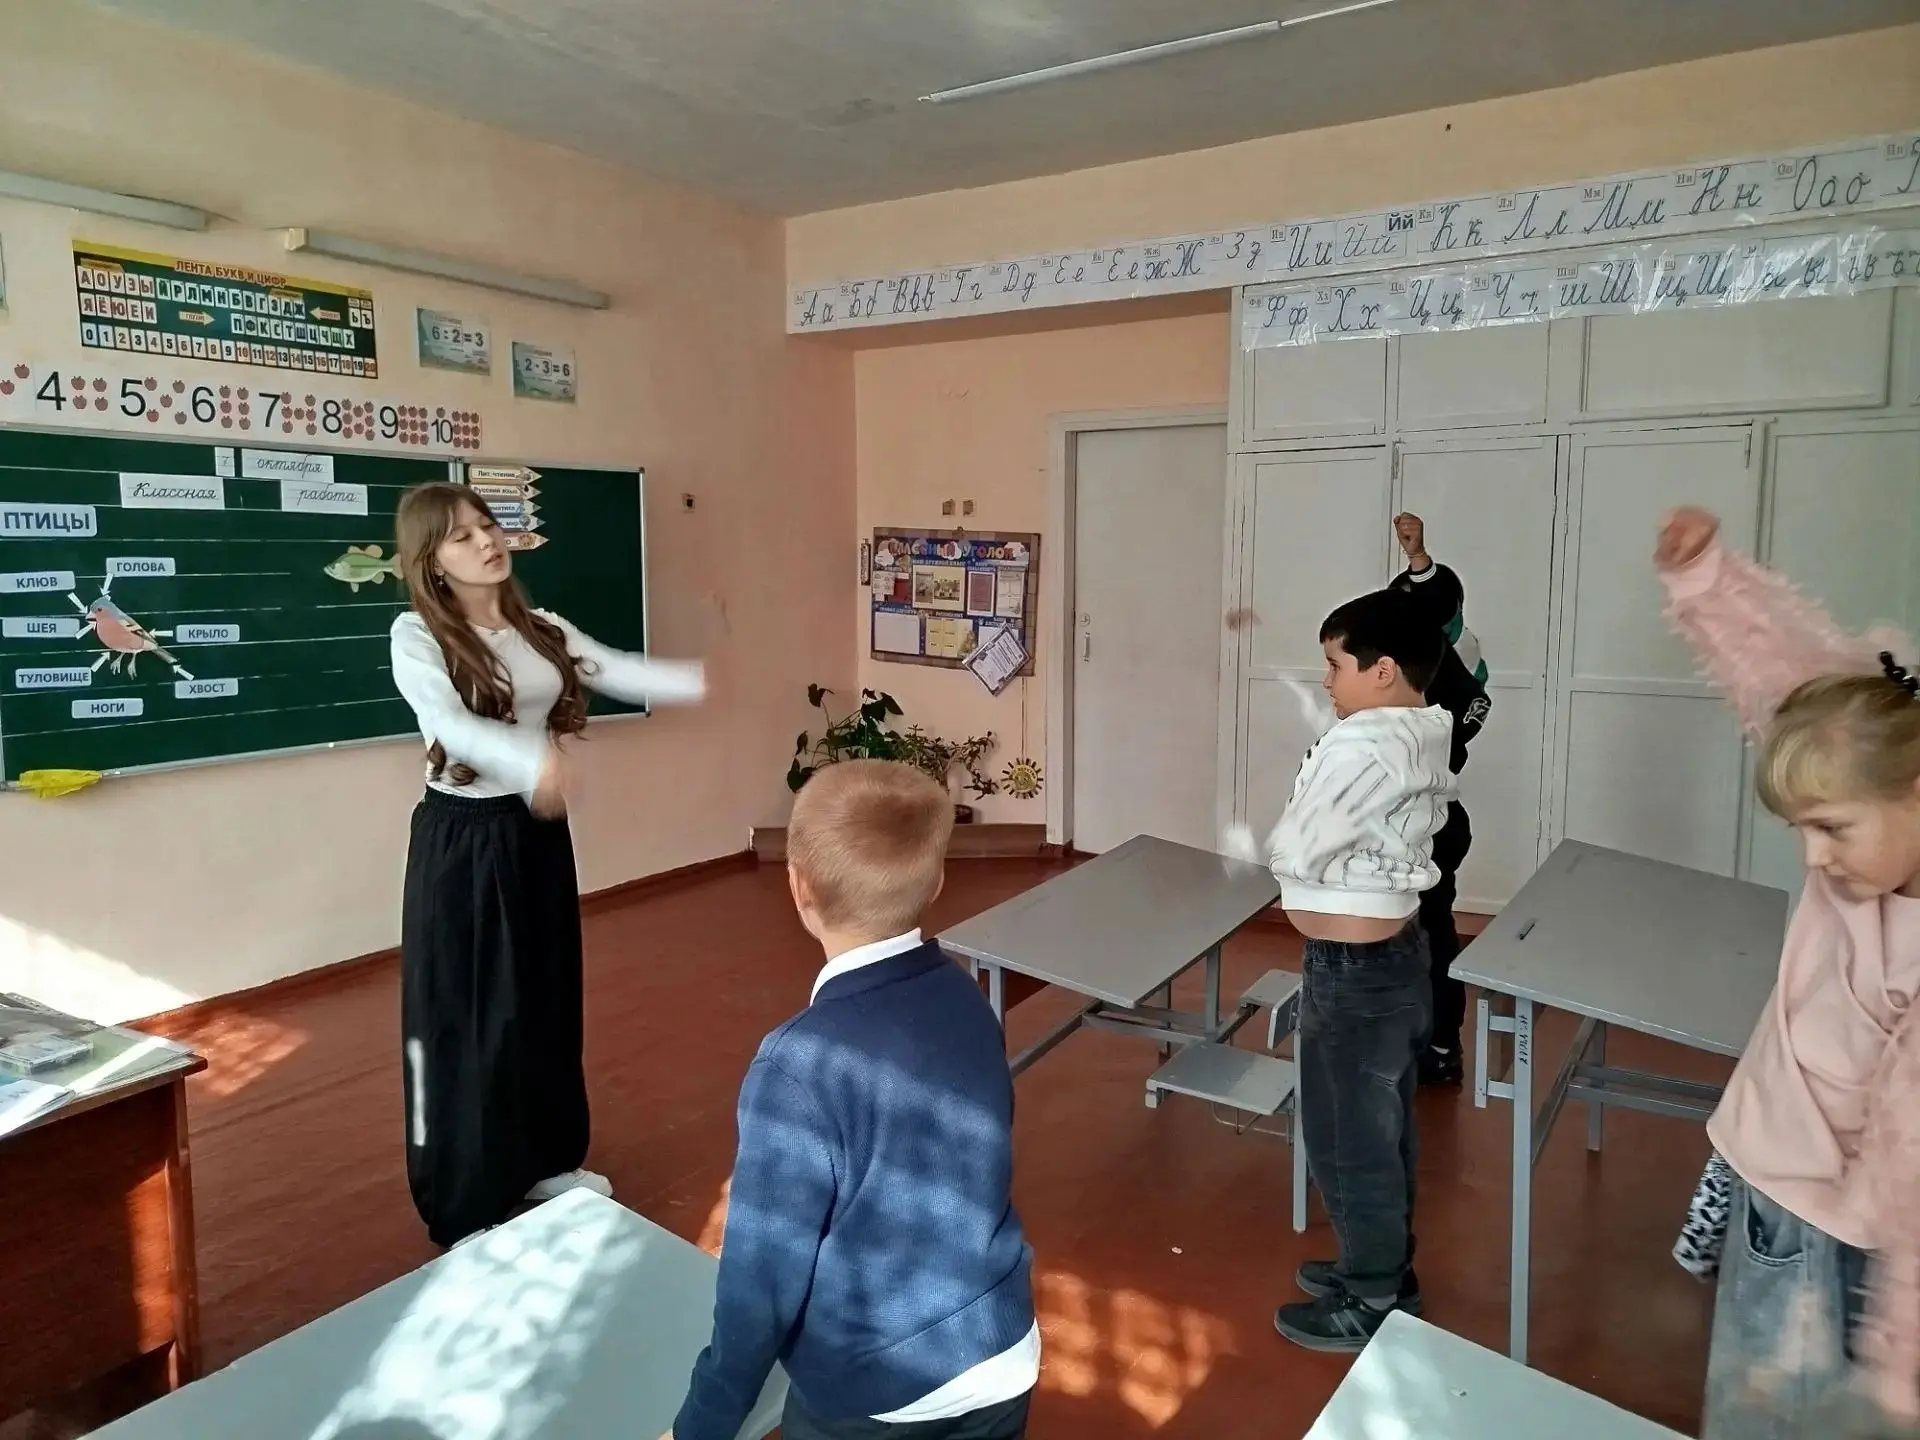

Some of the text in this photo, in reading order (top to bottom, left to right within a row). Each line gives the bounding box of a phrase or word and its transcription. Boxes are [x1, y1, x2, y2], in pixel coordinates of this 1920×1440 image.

[175, 260, 287, 285] ЛЕНТА БУКВ И ЦИФР
[86, 329, 376, 372] 0 1 2 3 4 5 6 7 8 9 10 11 12 13 14 15 16 17 18 19 20
[36, 371, 453, 443] 4 5 6 7 8 9 10
[256, 455, 324, 478] октября
[133, 482, 216, 499] Классная
[4, 511, 91, 532] ПТИЦЫ
[116, 562, 166, 572] ГОЛОВА
[16, 577, 58, 588] КЛЮВ
[27, 623, 57, 634] ШЕЯ
[188, 628, 229, 639] КРЫЛО
[19, 672, 90, 684] ТУЛОВИЩЕ
[189, 683, 226, 694] ХВОСТ
[91, 703, 125, 713] НОГИ
